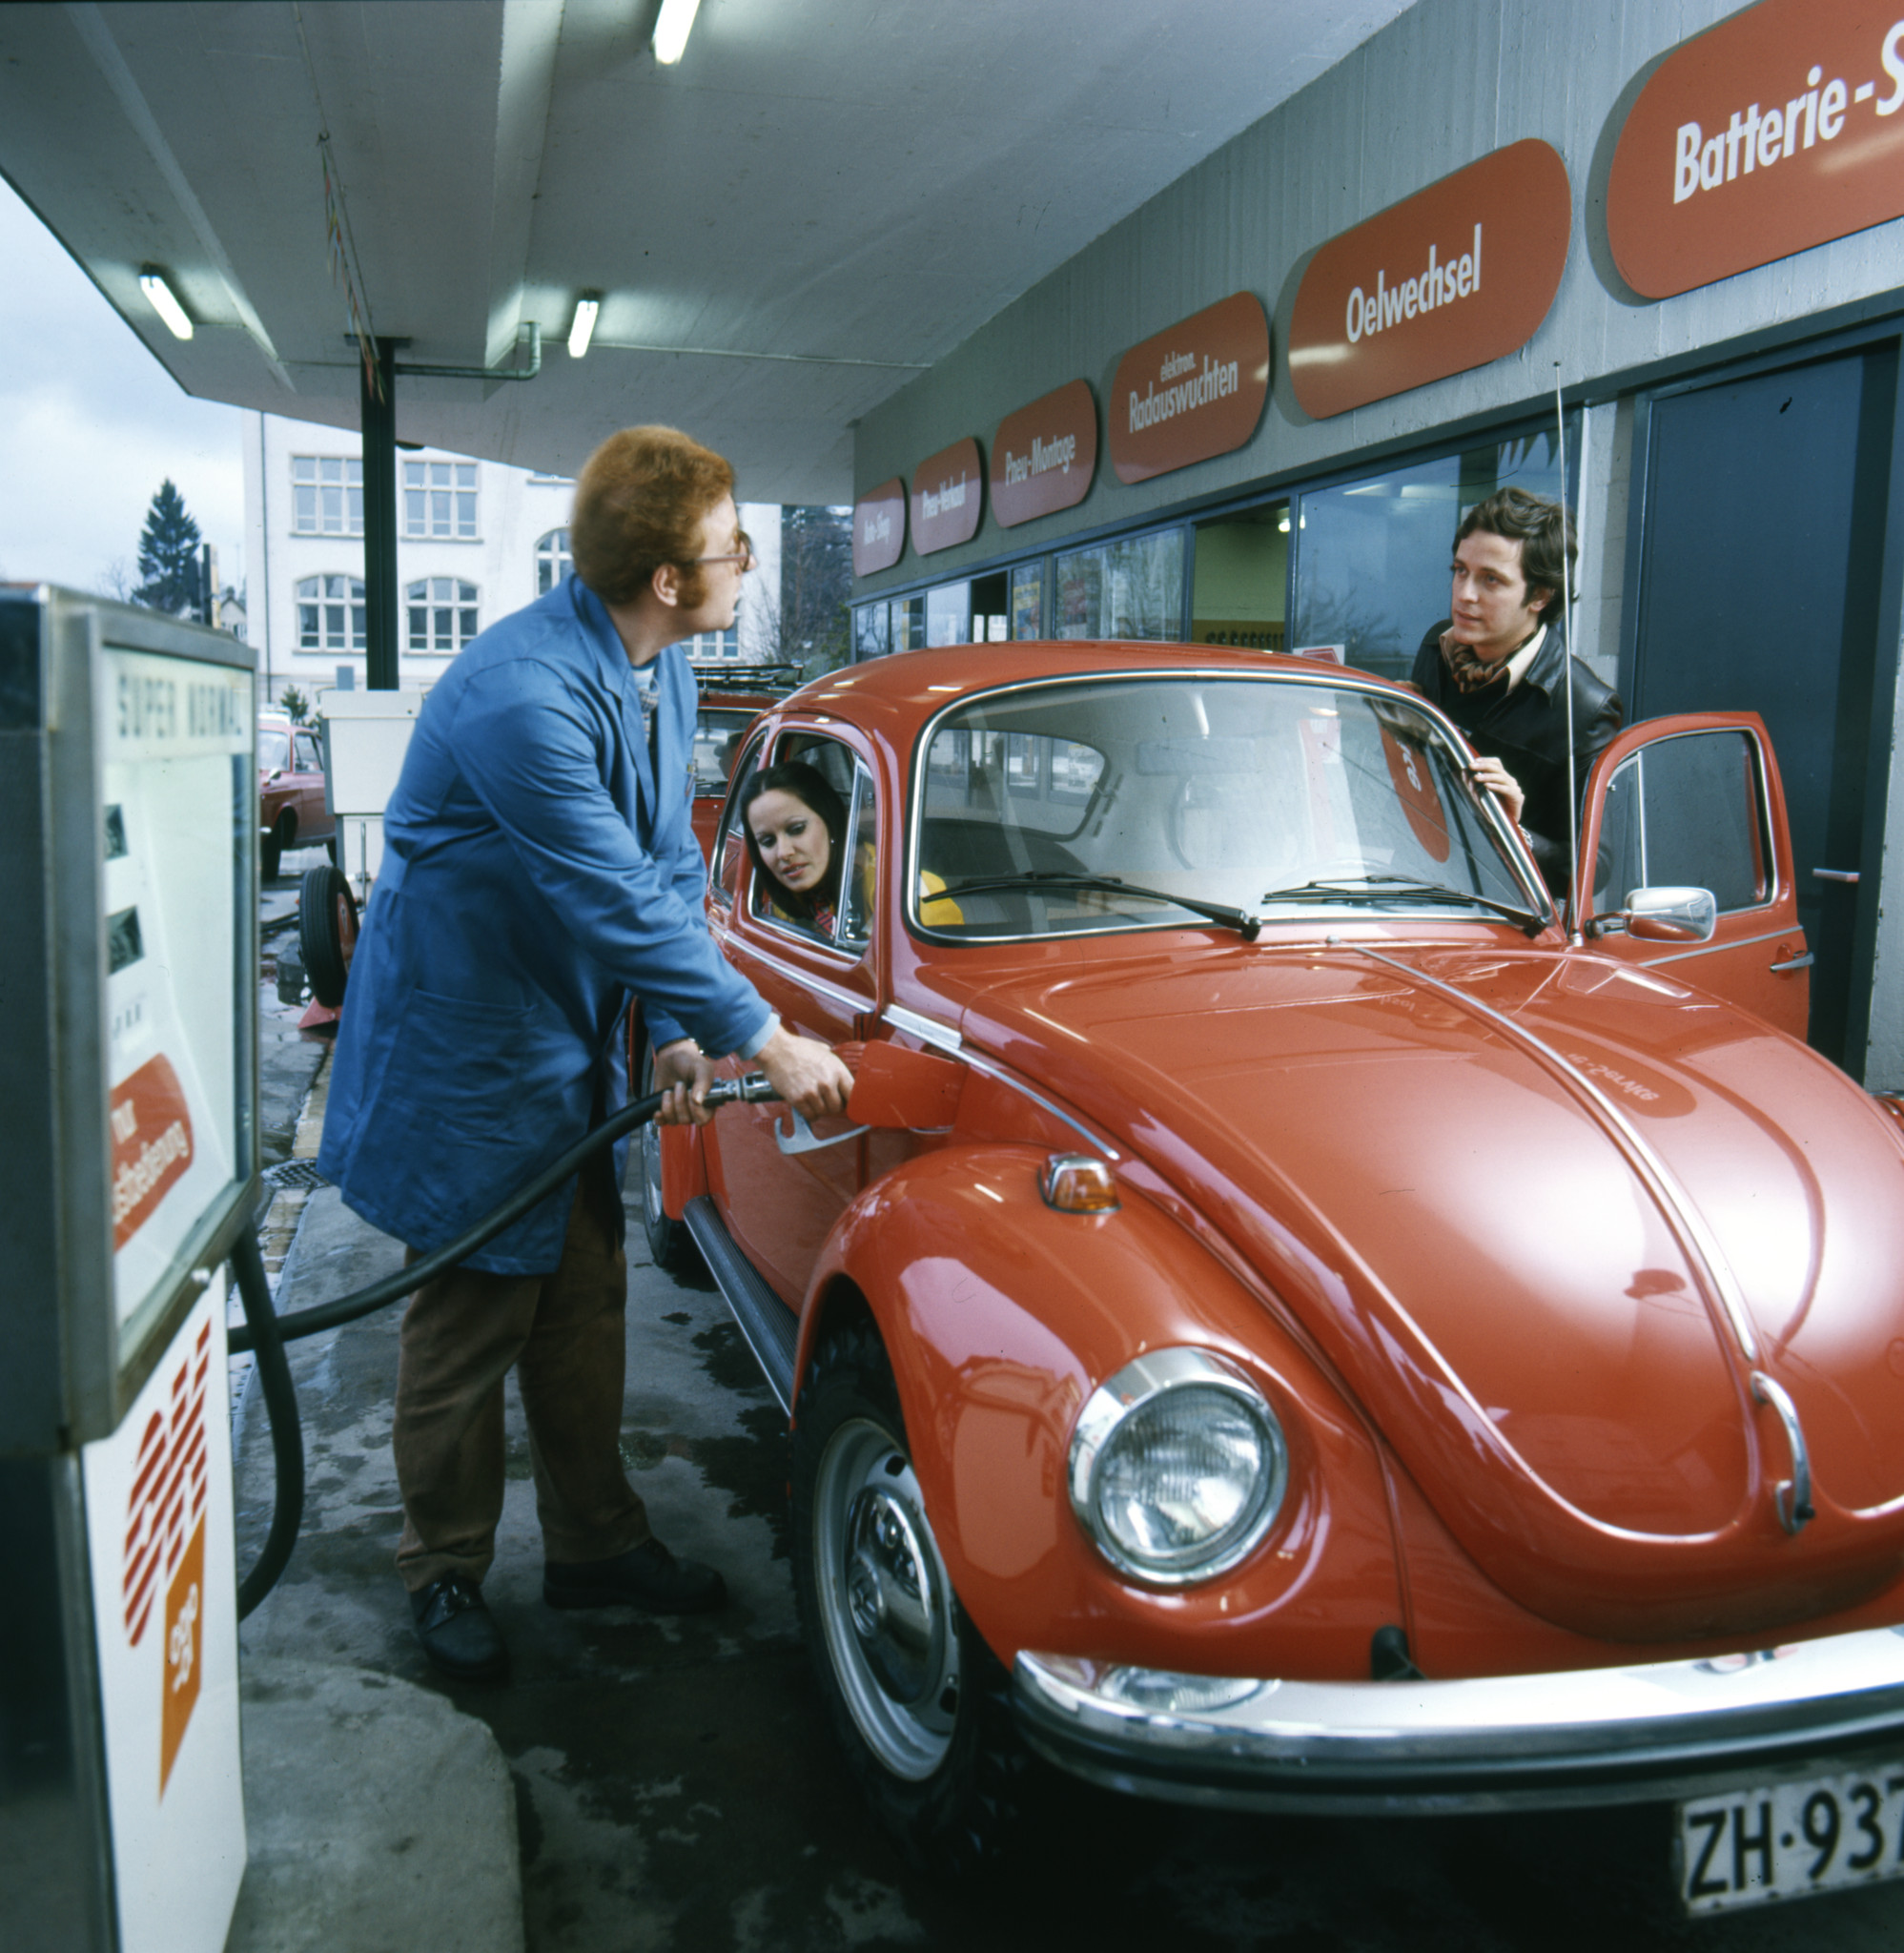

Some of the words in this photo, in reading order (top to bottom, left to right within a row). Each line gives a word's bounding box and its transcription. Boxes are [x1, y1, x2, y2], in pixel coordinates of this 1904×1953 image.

[1346, 223, 1482, 342] Oelwechsel
[1129, 356, 1239, 433] Radauswuchten
[1160, 351, 1196, 382] elektron.
[1005, 433, 1075, 487] Pneu-Montage
